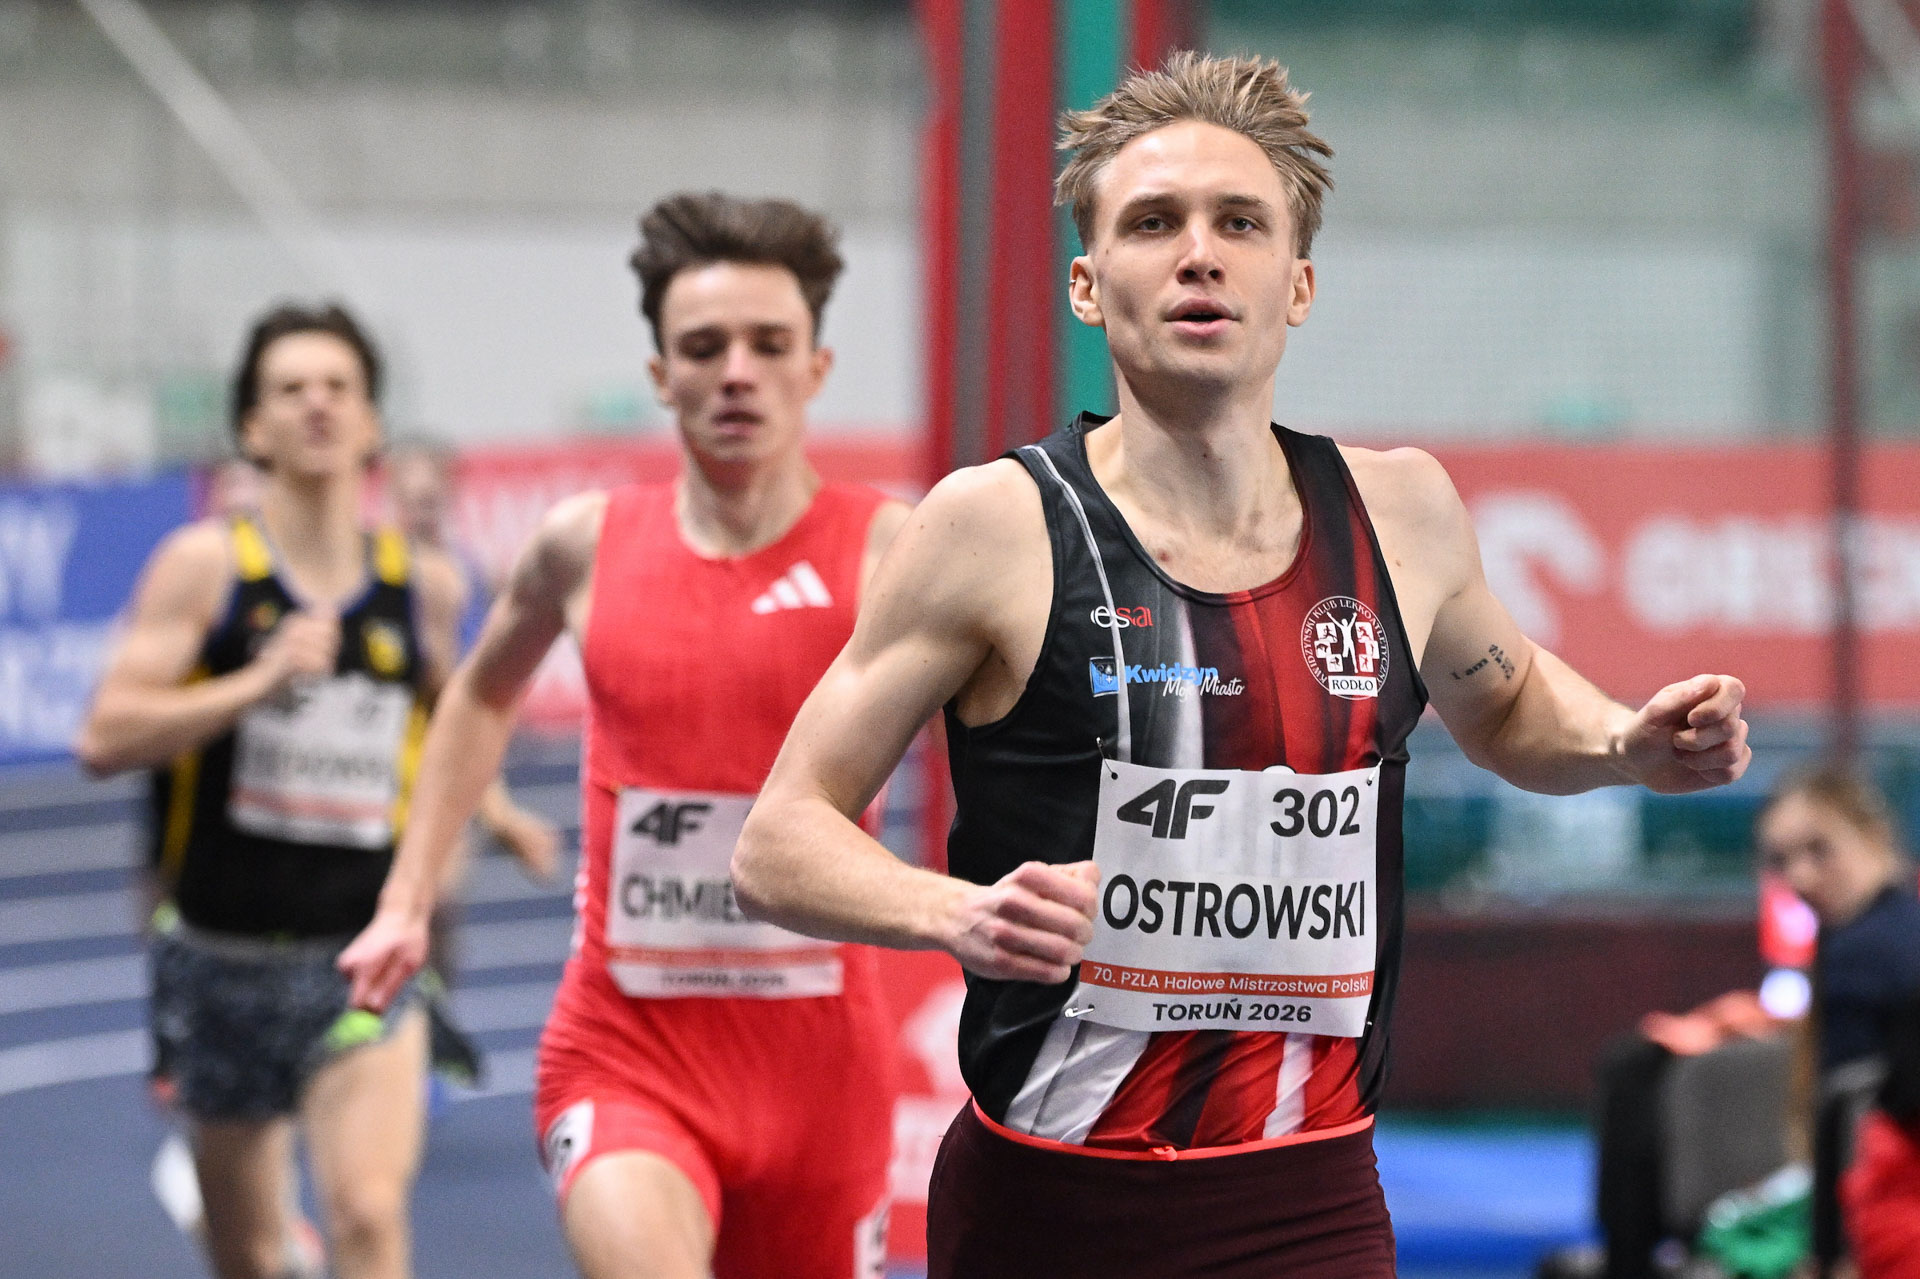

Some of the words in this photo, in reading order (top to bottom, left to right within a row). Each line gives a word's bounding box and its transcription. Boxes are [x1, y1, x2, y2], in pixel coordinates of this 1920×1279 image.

[1312, 600, 1338, 619] KLUB
[1125, 662, 1219, 686] Kwidzyn
[1200, 676, 1244, 696] Miasto
[1332, 679, 1374, 691] RODŁO
[1117, 779, 1230, 839] 4F
[1270, 786, 1360, 838] 302
[632, 803, 712, 845] 4F
[1102, 874, 1365, 940] OSTROWSKI
[1093, 967, 1116, 984] 70.
[1121, 972, 1159, 989] PZLA
[1165, 976, 1225, 990] Halowe
[1229, 977, 1327, 993] Mistrzostwa
[1332, 975, 1369, 993] Polski
[1152, 998, 1242, 1022] TORUŃ
[1249, 1003, 1312, 1022] 2026
